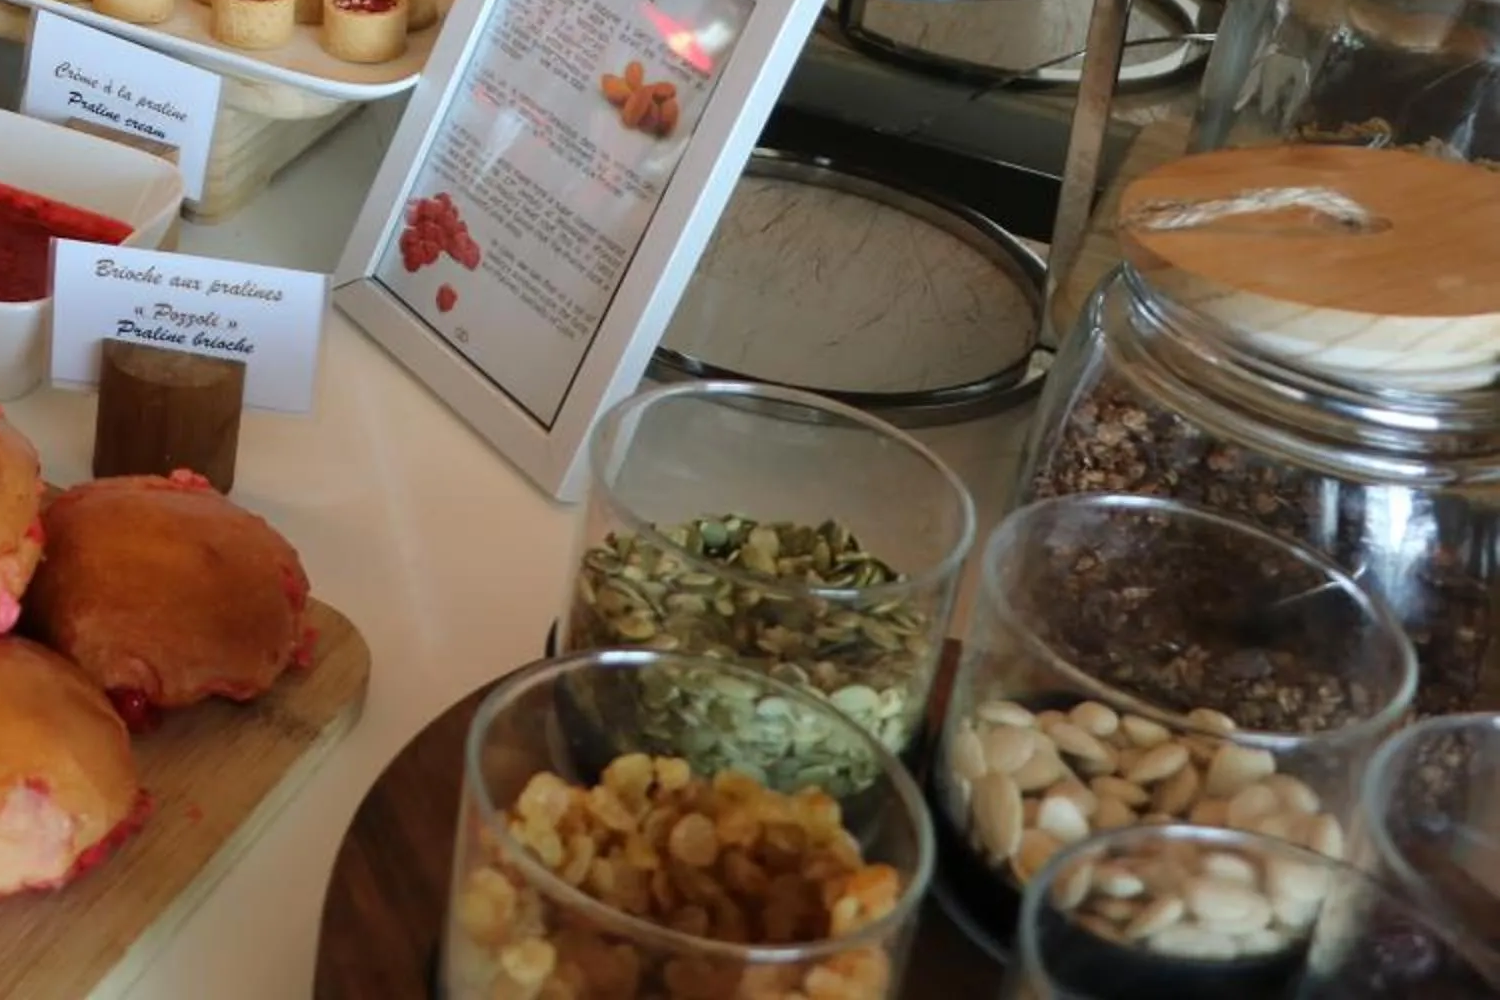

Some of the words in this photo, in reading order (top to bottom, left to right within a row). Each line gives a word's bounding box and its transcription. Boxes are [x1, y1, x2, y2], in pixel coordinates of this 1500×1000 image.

[67, 91, 121, 122] Praline
[124, 117, 166, 139] cream
[117, 84, 133, 101] la
[136, 96, 188, 121] praline
[94, 258, 163, 286] Brioche
[169, 274, 202, 292] aux
[205, 279, 285, 302] pralines
[152, 302, 220, 329] Pozzoli
[116, 319, 187, 346] Praline
[192, 330, 255, 355] brioche
